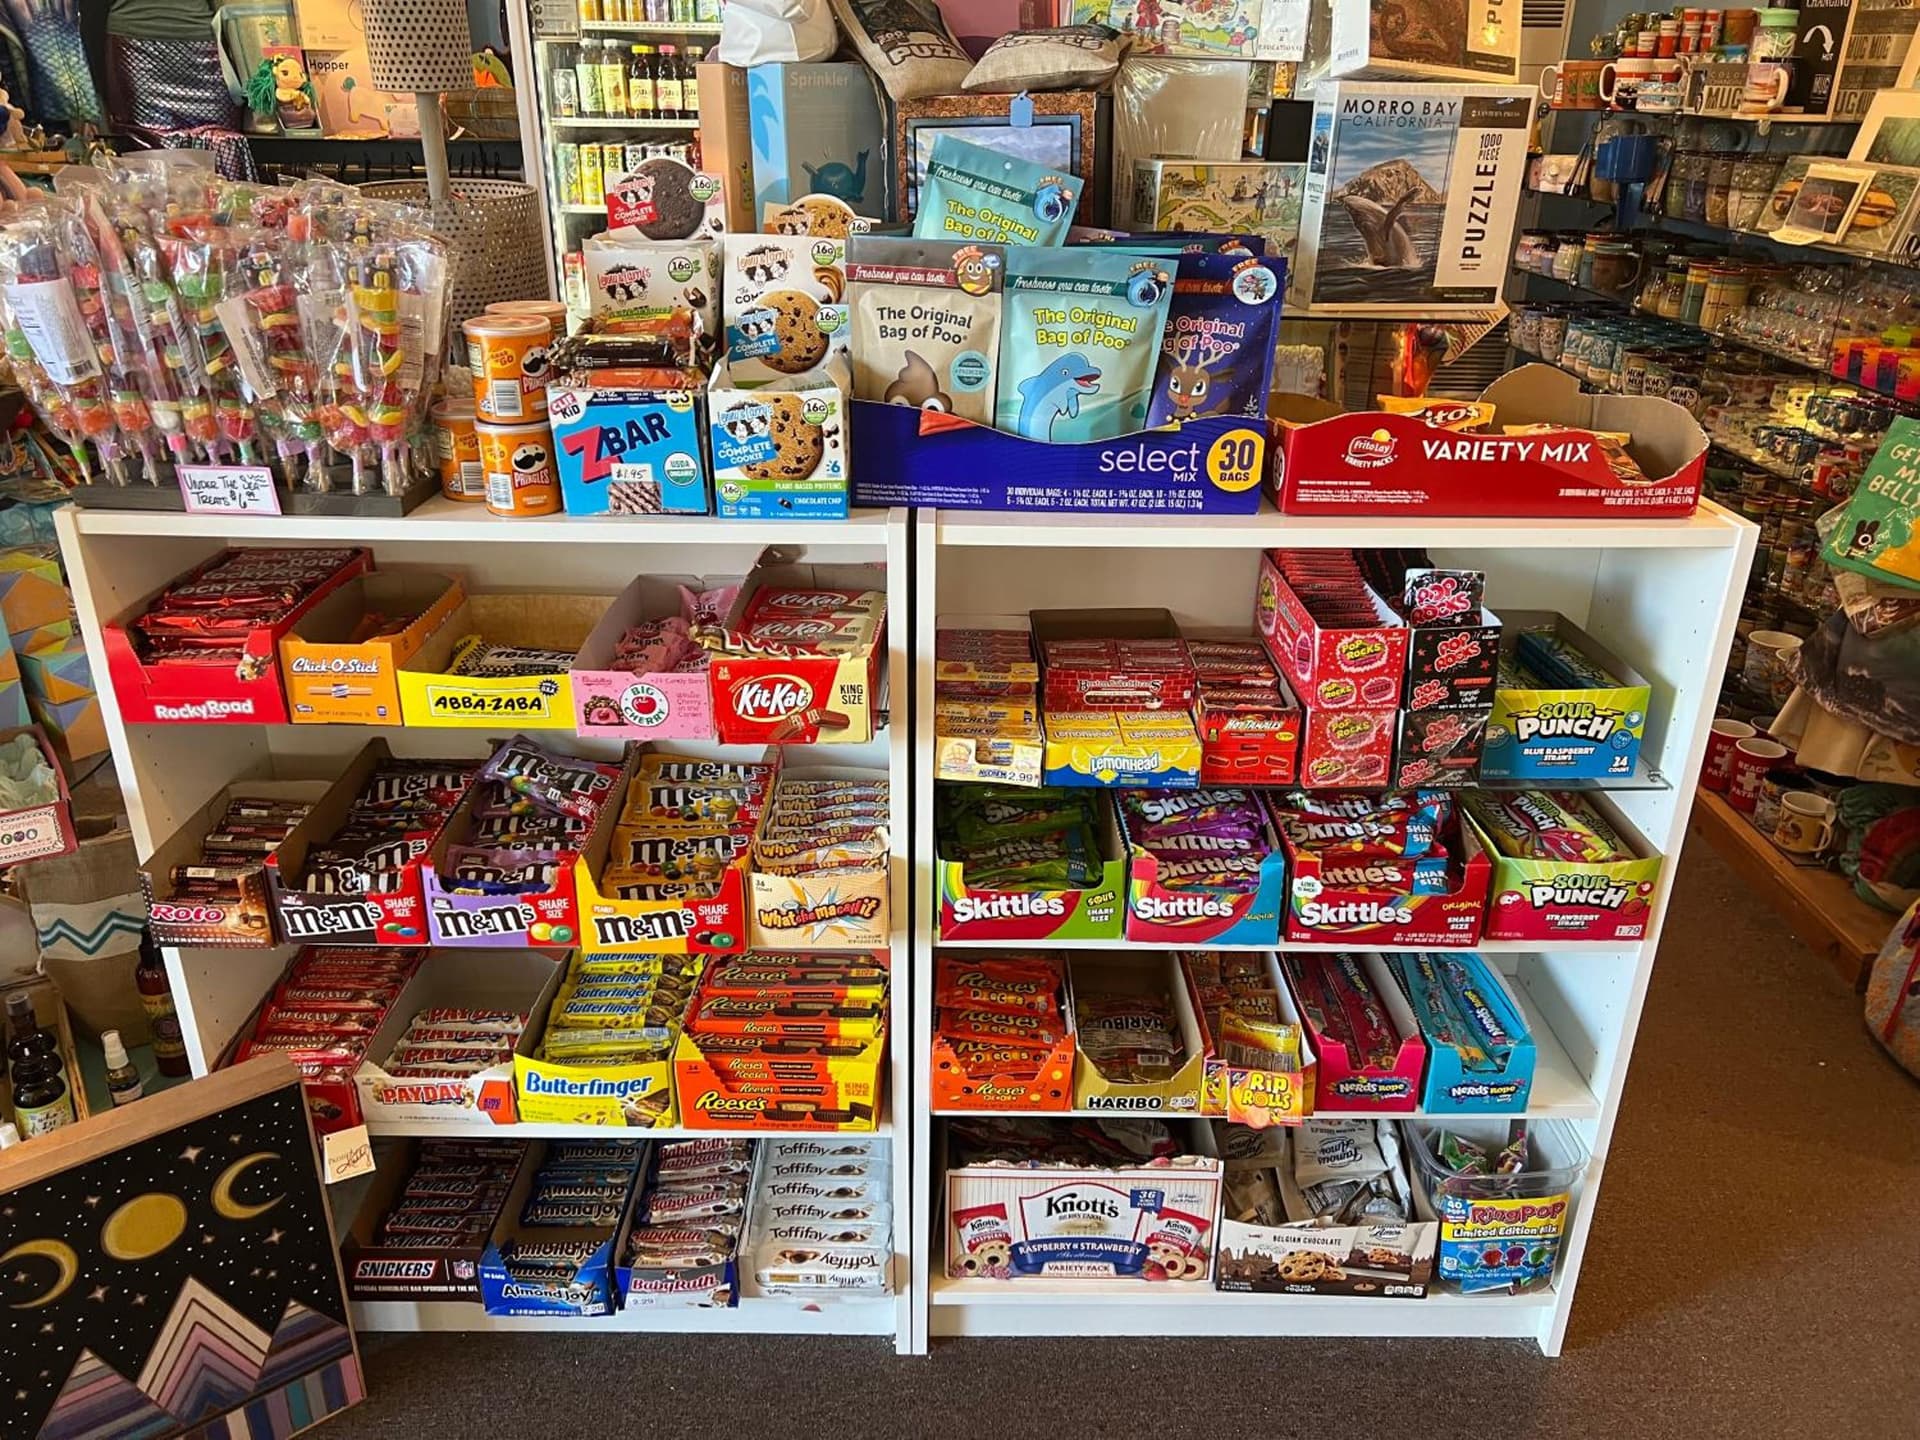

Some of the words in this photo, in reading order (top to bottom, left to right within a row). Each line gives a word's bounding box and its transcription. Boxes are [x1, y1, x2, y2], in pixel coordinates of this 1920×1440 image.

[310, 59, 350, 73] Hopper
[790, 71, 849, 88] Sprinkler
[1343, 99, 1414, 116] MORRO
[1422, 101, 1458, 116] BAY
[1706, 87, 1743, 114] MUG
[1352, 115, 1443, 128] CALIFORNIA
[1480, 133, 1502, 148] 1000
[1478, 147, 1501, 160] PIECE
[936, 165, 972, 186] freshness
[973, 180, 987, 192] you
[614, 205, 655, 221] COMPLETE
[1461, 164, 1497, 259] PUZZLE
[947, 200, 975, 218] The
[978, 209, 1039, 241] Original
[944, 218, 972, 238] Bag
[976, 225, 993, 240] of
[855, 267, 893, 281] freshness
[893, 271, 908, 283] you
[1013, 278, 1056, 290] freshness
[1057, 282, 1072, 293] you
[877, 307, 907, 320] The
[910, 307, 972, 330] Original
[1033, 308, 1066, 324] The
[1070, 308, 1138, 332] Original
[880, 325, 907, 341] Bag
[912, 325, 928, 337] of
[932, 328, 963, 345] Poo
[1176, 316, 1244, 338] Original
[735, 338, 776, 353] COMPLETE
[1036, 329, 1068, 347] Bag
[1072, 329, 1090, 344] of
[1093, 332, 1127, 350] Poo
[1179, 334, 1197, 349] of
[1201, 337, 1234, 353] Poo
[719, 442, 772, 459] COMPLETE
[731, 453, 763, 464] COOKIE
[1099, 443, 1200, 472] select
[1219, 440, 1254, 471] 30
[1423, 441, 1535, 462] VARIETY
[1541, 443, 1591, 462] MIX
[670, 460, 690, 468] USDA
[514, 469, 549, 488] PRINGLES
[616, 469, 648, 480] $1.95
[1173, 470, 1198, 482] MIX
[1219, 472, 1250, 482] BAGS
[1416, 578, 1457, 606] POP
[1411, 591, 1471, 625] ROCKS
[1341, 639, 1363, 653] POP
[1347, 643, 1383, 660] ROCKS
[1437, 632, 1470, 655] POP
[1434, 641, 1481, 672] ROCKS
[291, 658, 379, 674] Chick-O-Stick
[631, 686, 654, 696] BIG
[840, 685, 863, 694] KING
[1414, 679, 1441, 699] POP
[434, 695, 542, 711] ABBA-ZABA
[736, 683, 808, 716] KitKat
[842, 695, 863, 705] SIZE
[1411, 686, 1449, 711] ROCKS
[624, 706, 666, 725] CHERRY
[1539, 703, 1594, 719] SOUR
[1517, 716, 1615, 742] PUNCH
[1523, 748, 1544, 756] BLUE
[1546, 747, 1595, 756] RASPBERRY
[1612, 756, 1628, 767] 24
[1008, 771, 1033, 783] 2.99
[1142, 790, 1247, 822] Skittles
[1289, 820, 1397, 843] Skittles
[1157, 855, 1260, 882] Skittles
[1321, 866, 1402, 885] kittles
[1554, 873, 1609, 889] SOUR
[384, 897, 417, 910] SHARE
[538, 899, 569, 911] SHARE
[1532, 887, 1628, 909] PUNCH
[151, 904, 226, 924] Rolo
[393, 907, 412, 918] SIZE
[546, 908, 564, 919] SIZE
[698, 904, 729, 916] SHARE
[759, 898, 881, 930] Whatchamacallit
[954, 893, 1065, 922] Skittles
[1134, 896, 1234, 919] Skittles
[1300, 900, 1412, 927] Skittles
[280, 902, 383, 936] m&m's
[435, 900, 536, 938] m&m's
[706, 914, 723, 925] SIZE
[1546, 914, 1600, 922] STRAWBERRY
[1557, 920, 1588, 928] STRAWS
[594, 909, 697, 946] m&m's
[573, 987, 649, 1000] Butterfinger
[564, 1002, 642, 1016] Butterfinger
[525, 1072, 653, 1098] Butterfinger
[845, 1089, 871, 1097] SIZE
[975, 1082, 1026, 1096] Reese's
[382, 1083, 464, 1105] PAYDAY
[696, 1091, 768, 1112] Reese's
[1088, 1096, 1163, 1110] HARIBO
[776, 1143, 829, 1157] Toffifay
[772, 1164, 826, 1177] Toffifay
[768, 1184, 824, 1198] Toffifay
[1139, 1190, 1157, 1200] 36
[772, 1206, 829, 1220] Toffifay
[1046, 1192, 1119, 1218] Knott's
[770, 1227, 828, 1241] Toffifay
[1453, 1225, 1497, 1238] Limited
[1499, 1224, 1537, 1238] Edition
[1540, 1224, 1558, 1236] Mix
[1273, 1235, 1301, 1244] BELGIAN
[1303, 1237, 1342, 1246] CHOCOLATE
[1019, 1243, 1072, 1255] RASPBERRY
[1079, 1242, 1142, 1256] STRAWBERRY
[819, 1253, 879, 1269] Toffifay
[1048, 1264, 1083, 1273] VARIETY
[1085, 1265, 1110, 1273] PACK
[357, 1261, 434, 1278] SNICKERS
[502, 1284, 564, 1300] Almond
[564, 1287, 594, 1304] Joy
